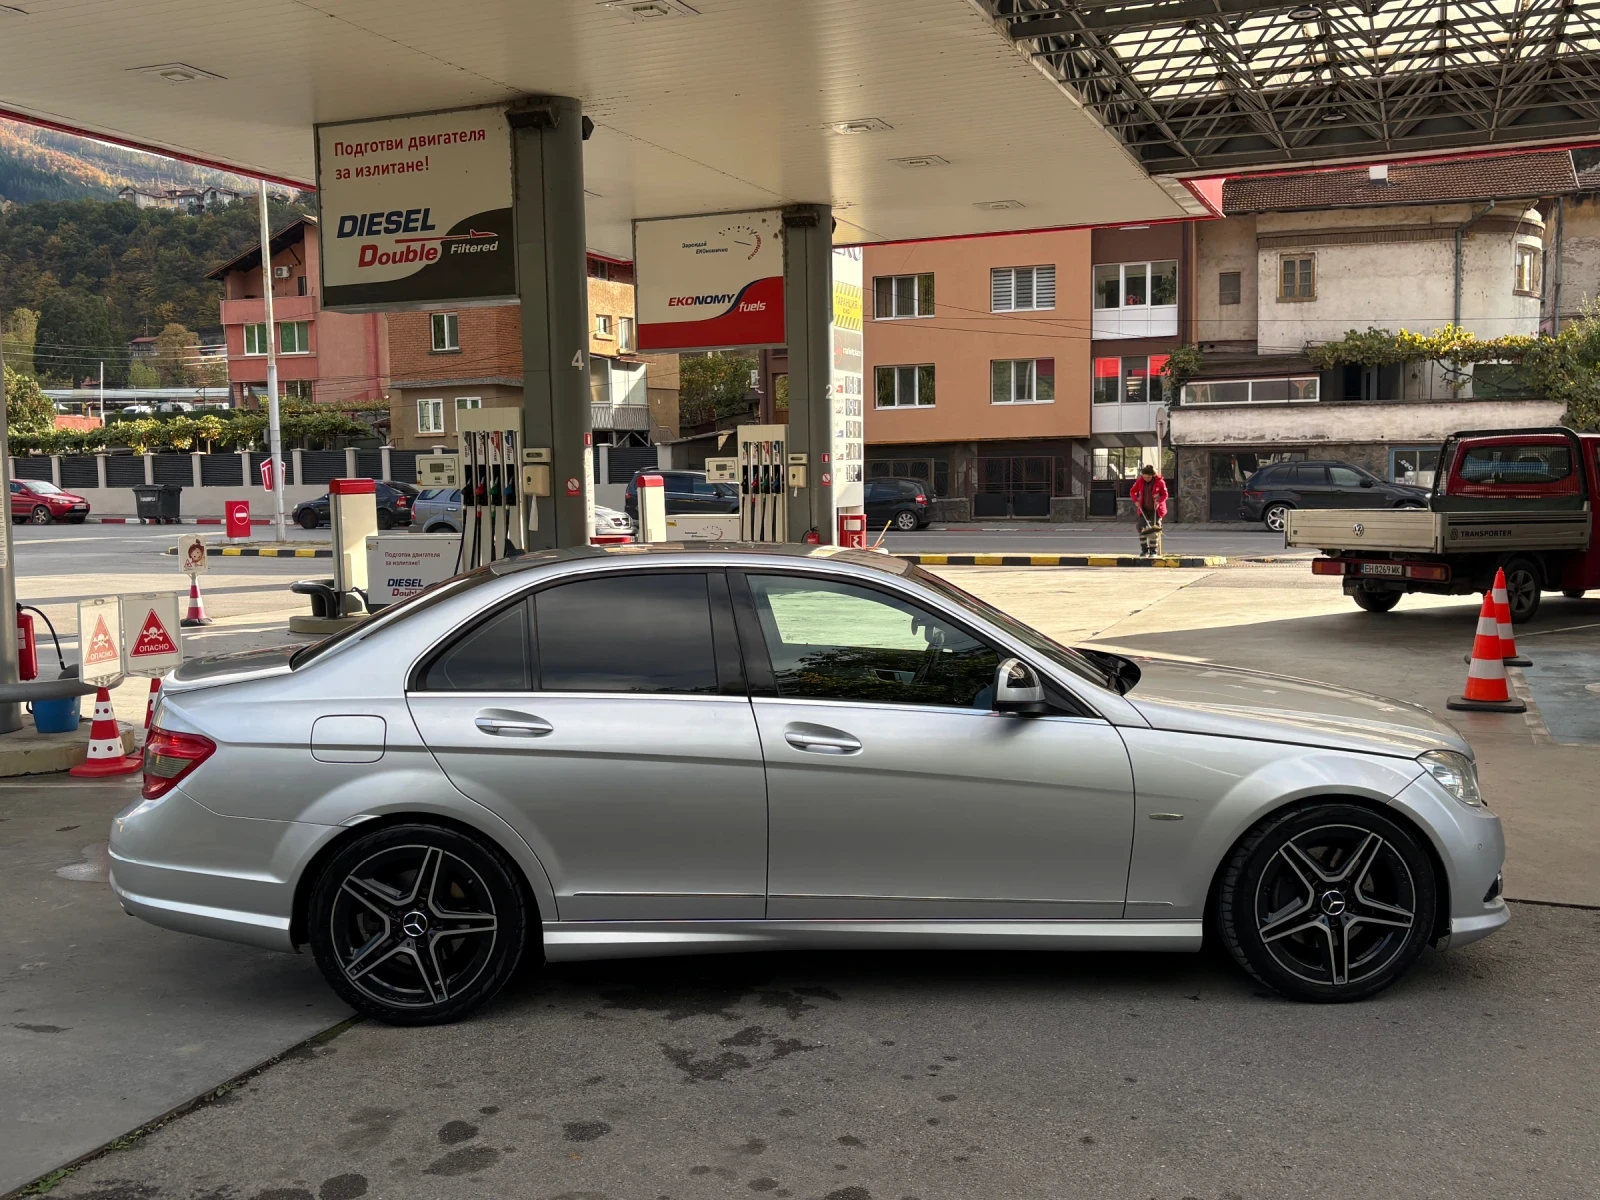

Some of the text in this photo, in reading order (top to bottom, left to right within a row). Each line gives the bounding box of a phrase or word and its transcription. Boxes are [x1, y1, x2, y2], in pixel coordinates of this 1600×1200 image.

[334, 128, 486, 158] Подготви двигателя
[335, 156, 430, 180] за излитане!
[336, 207, 436, 239] DIESEL
[358, 241, 499, 268] Double Filtered
[668, 293, 735, 307] EKONOMY
[738, 300, 766, 313] fuels
[571, 349, 585, 371] 4
[825, 384, 834, 399] 2
[1460, 529, 1512, 538] TRANSPORTER
[384, 551, 411, 559] Подготви
[387, 578, 424, 587] DIESEL
[138, 643, 170, 653] ОПАСНО
[90, 650, 113, 661] ОПАСНО
